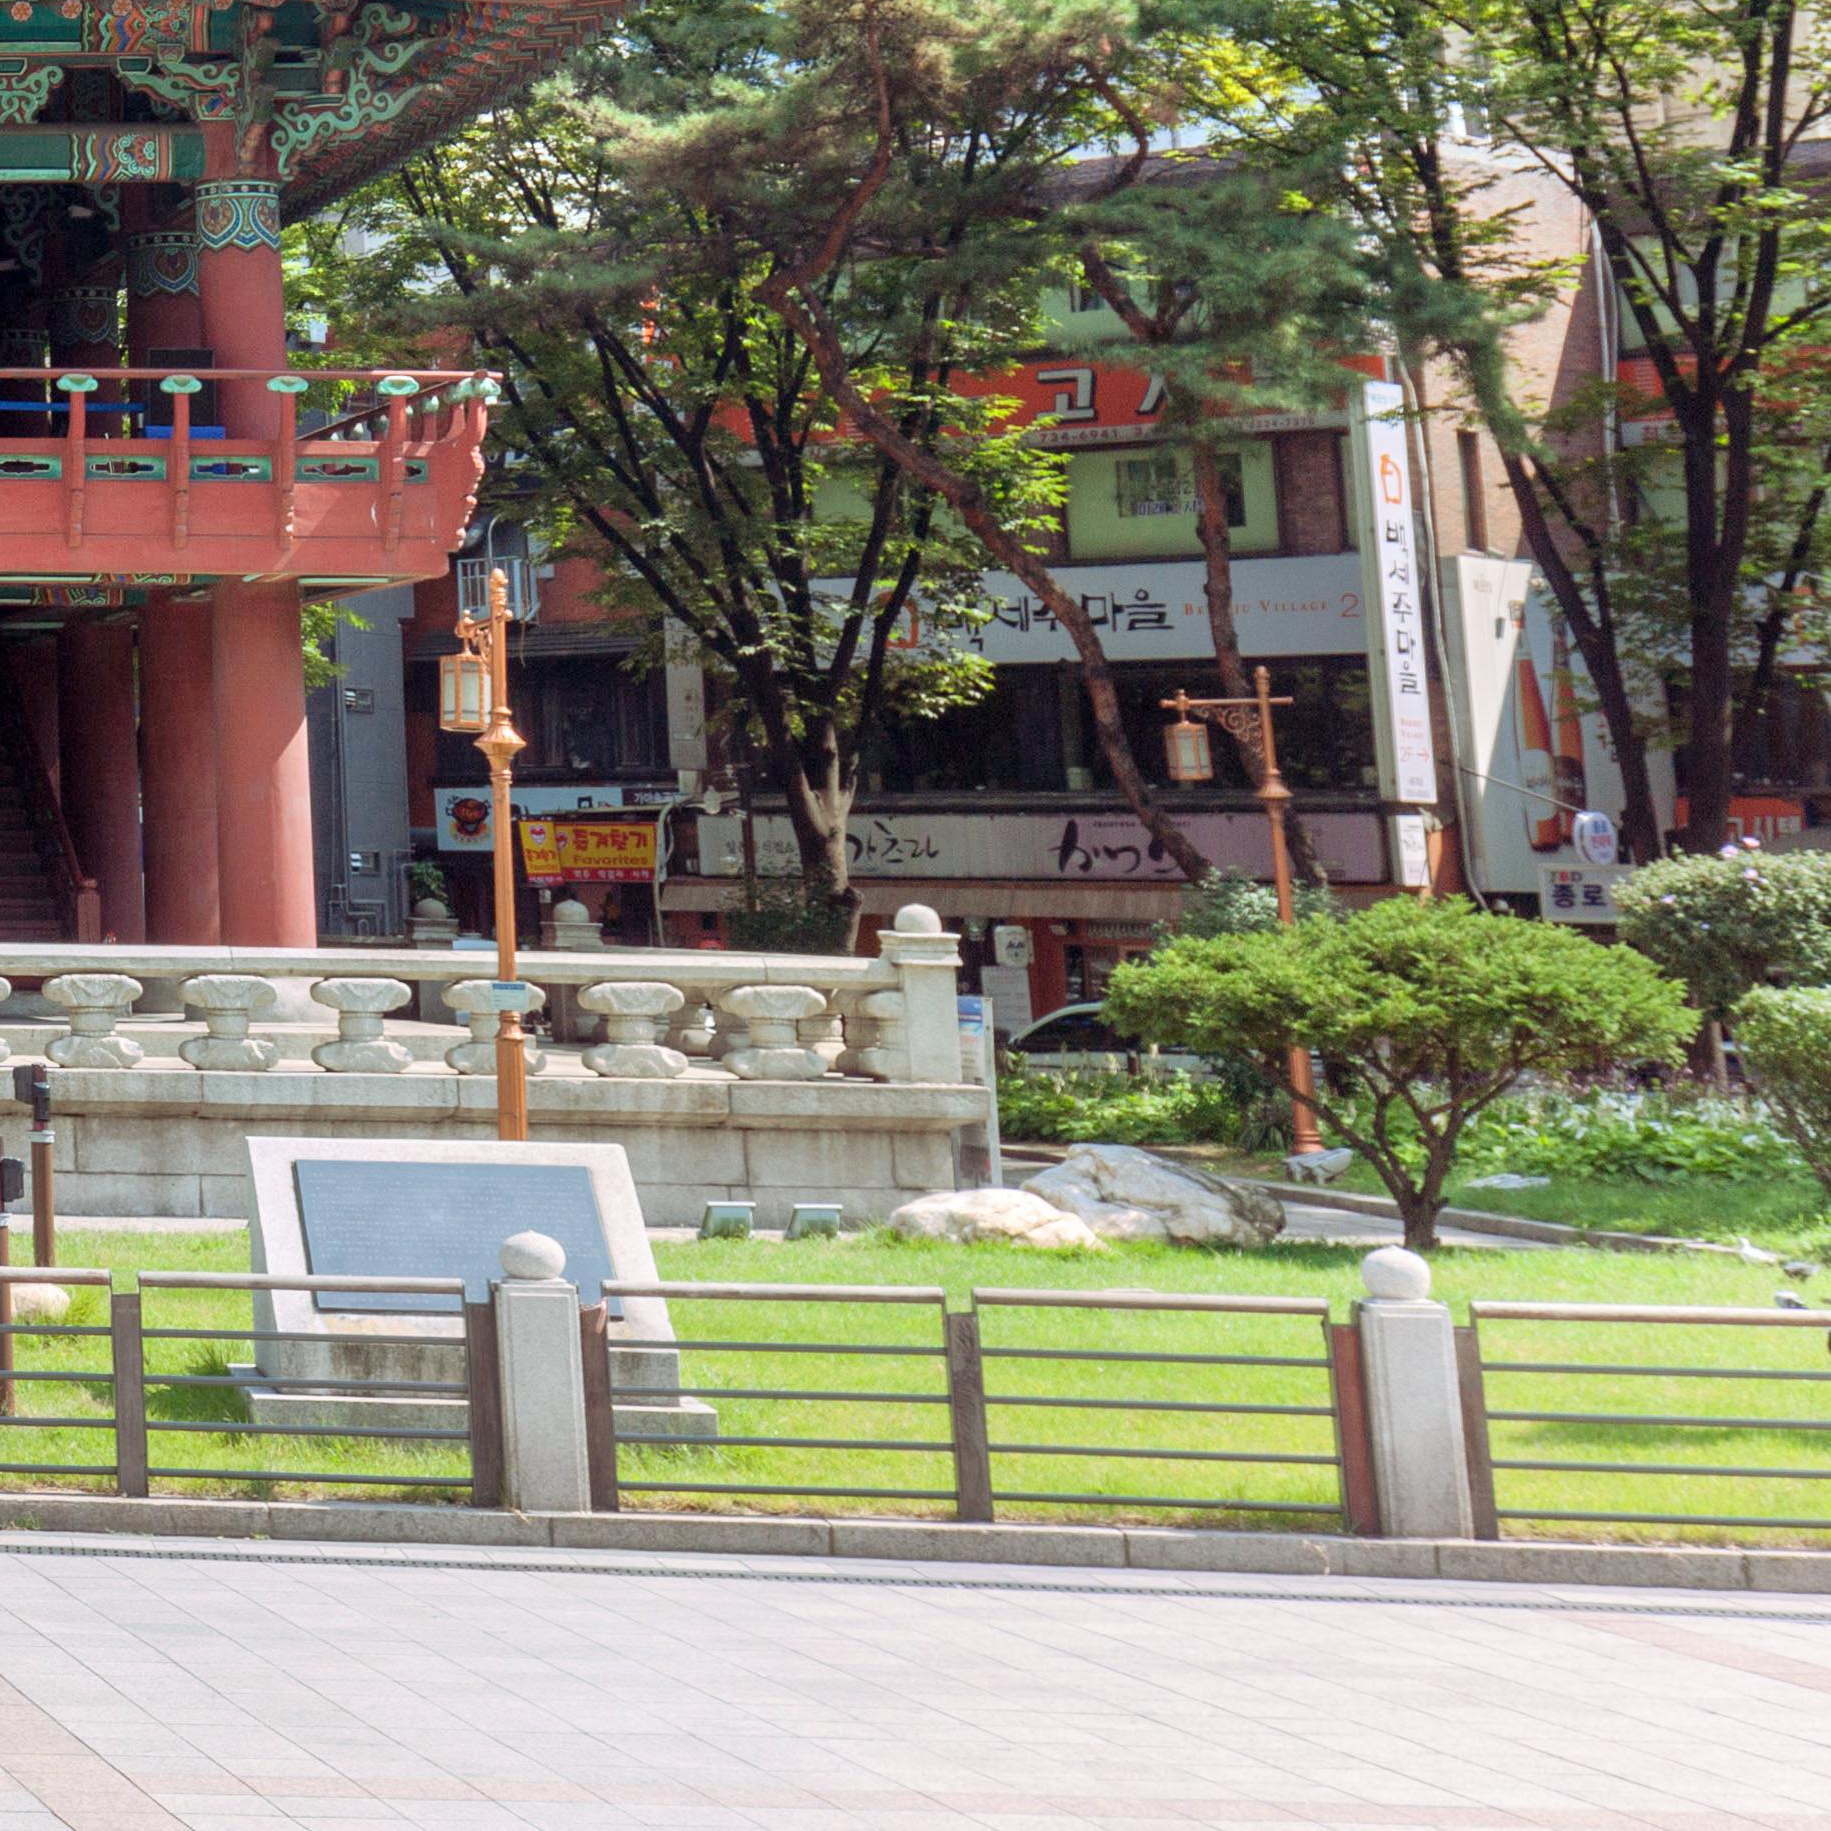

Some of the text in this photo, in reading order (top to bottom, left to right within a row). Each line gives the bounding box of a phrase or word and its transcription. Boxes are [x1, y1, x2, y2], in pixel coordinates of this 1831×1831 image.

[1342, 593, 1368, 619] 2
[1385, 519, 1422, 696] 백세주마을
[1551, 883, 1608, 908] 종로
